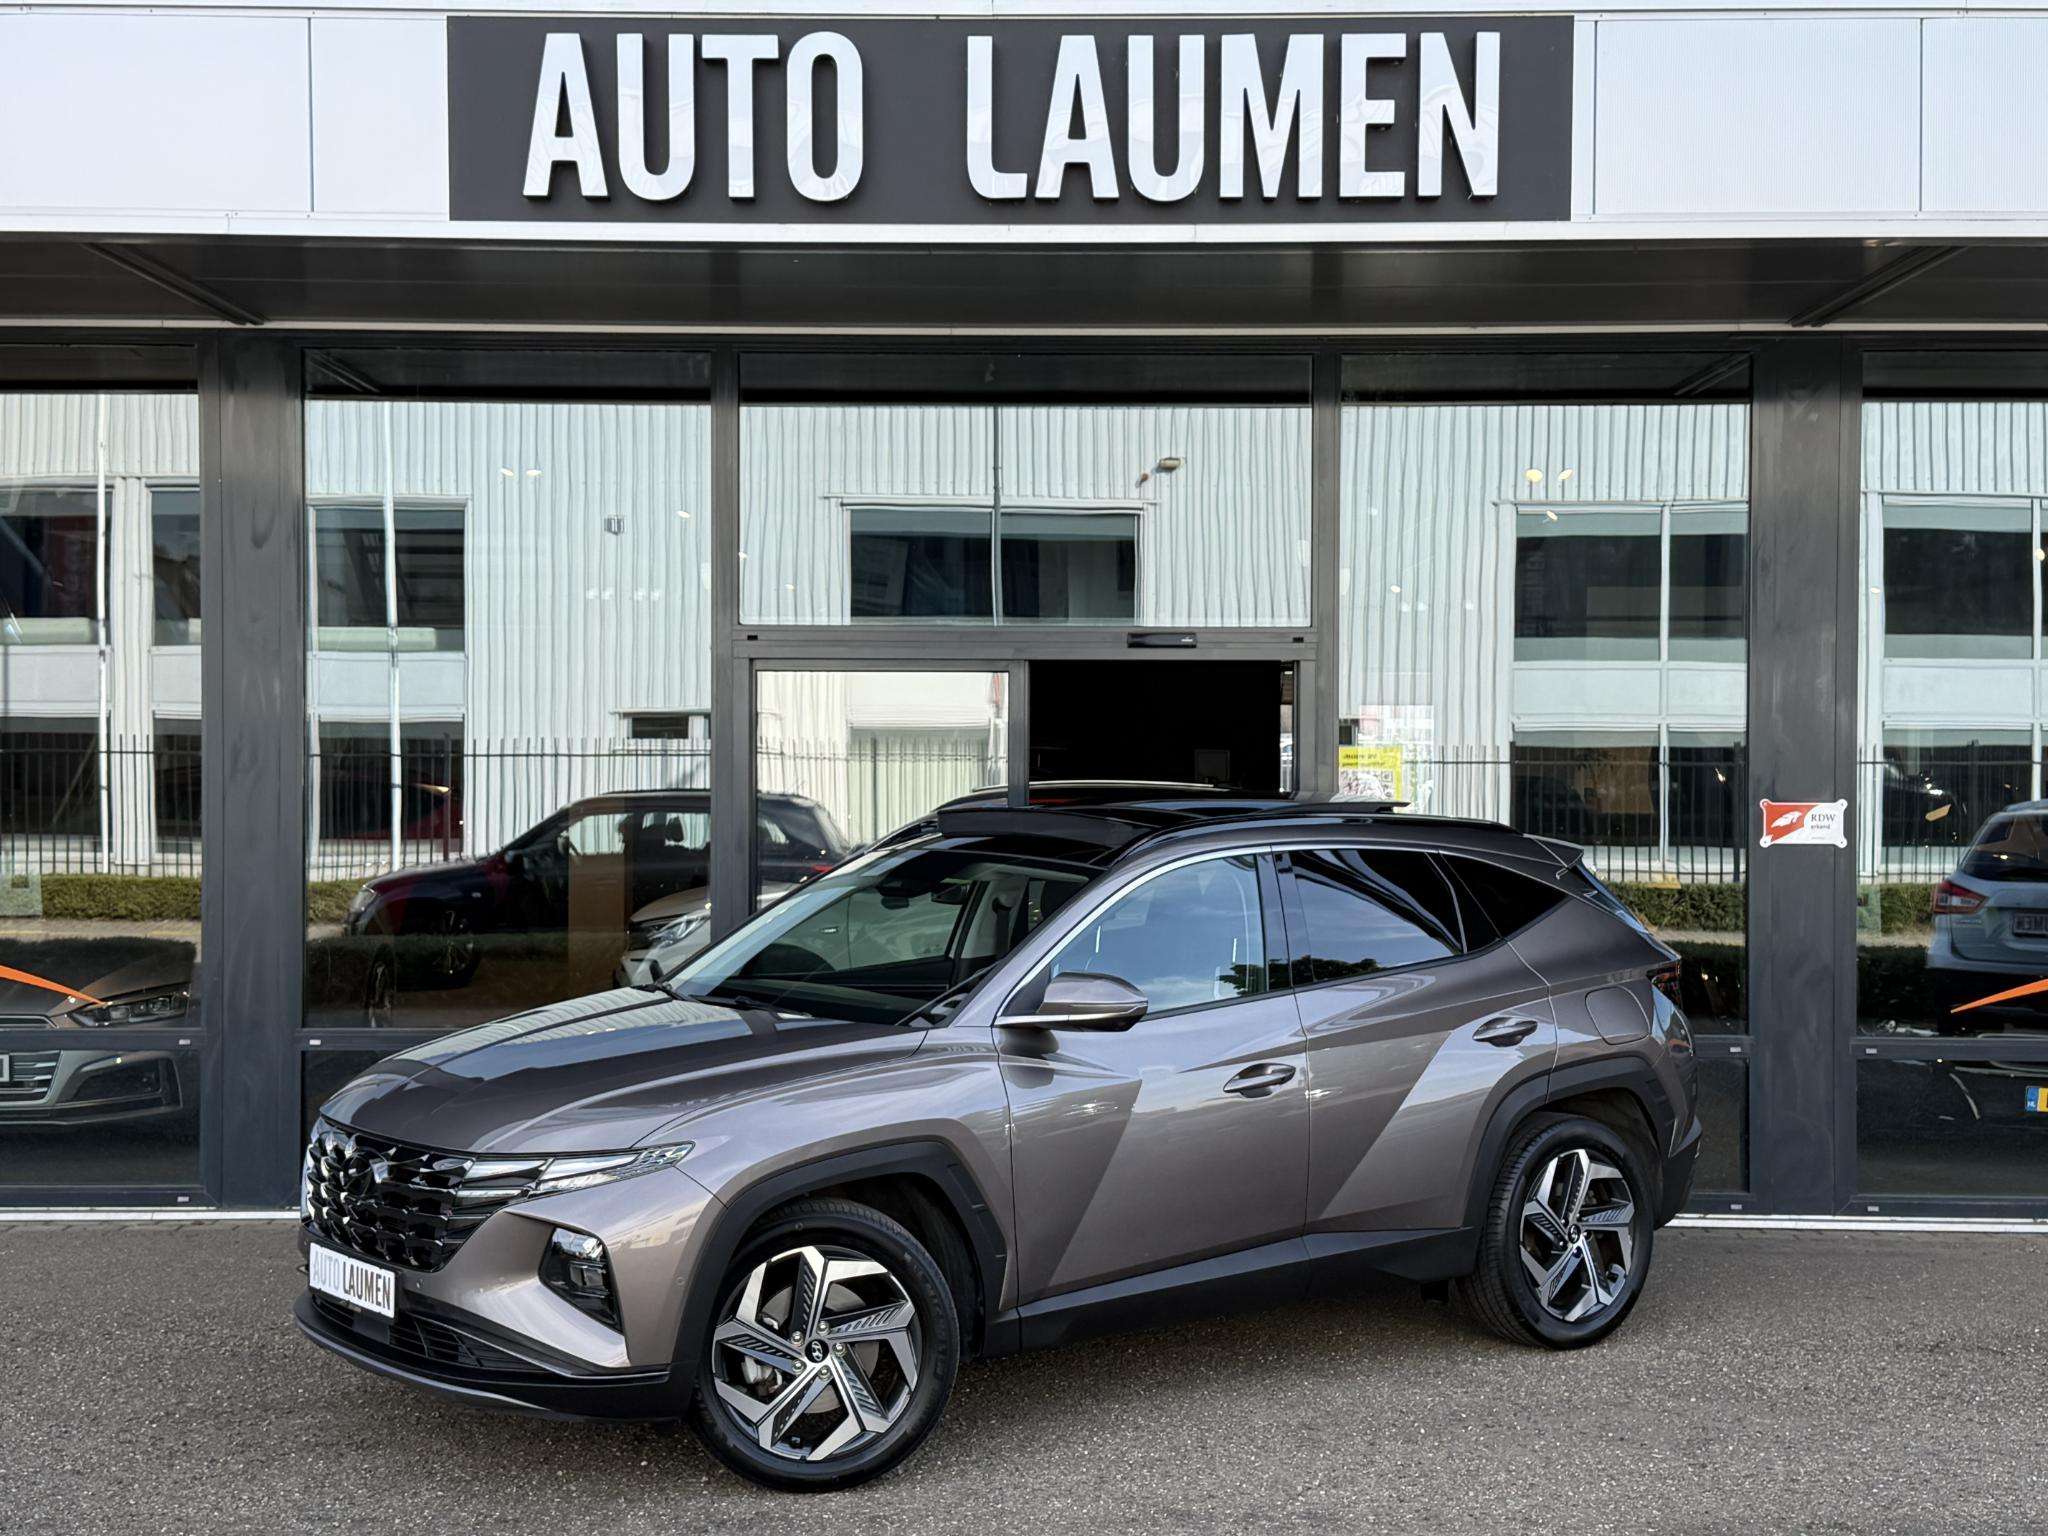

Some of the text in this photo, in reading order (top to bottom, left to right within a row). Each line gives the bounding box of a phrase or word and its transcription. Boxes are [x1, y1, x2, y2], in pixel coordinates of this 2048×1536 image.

[523, 31, 1502, 202] AUTO LAUMEN
[1810, 813, 1836, 822] RDW
[312, 1250, 391, 1311] AUTO LAUMEN
